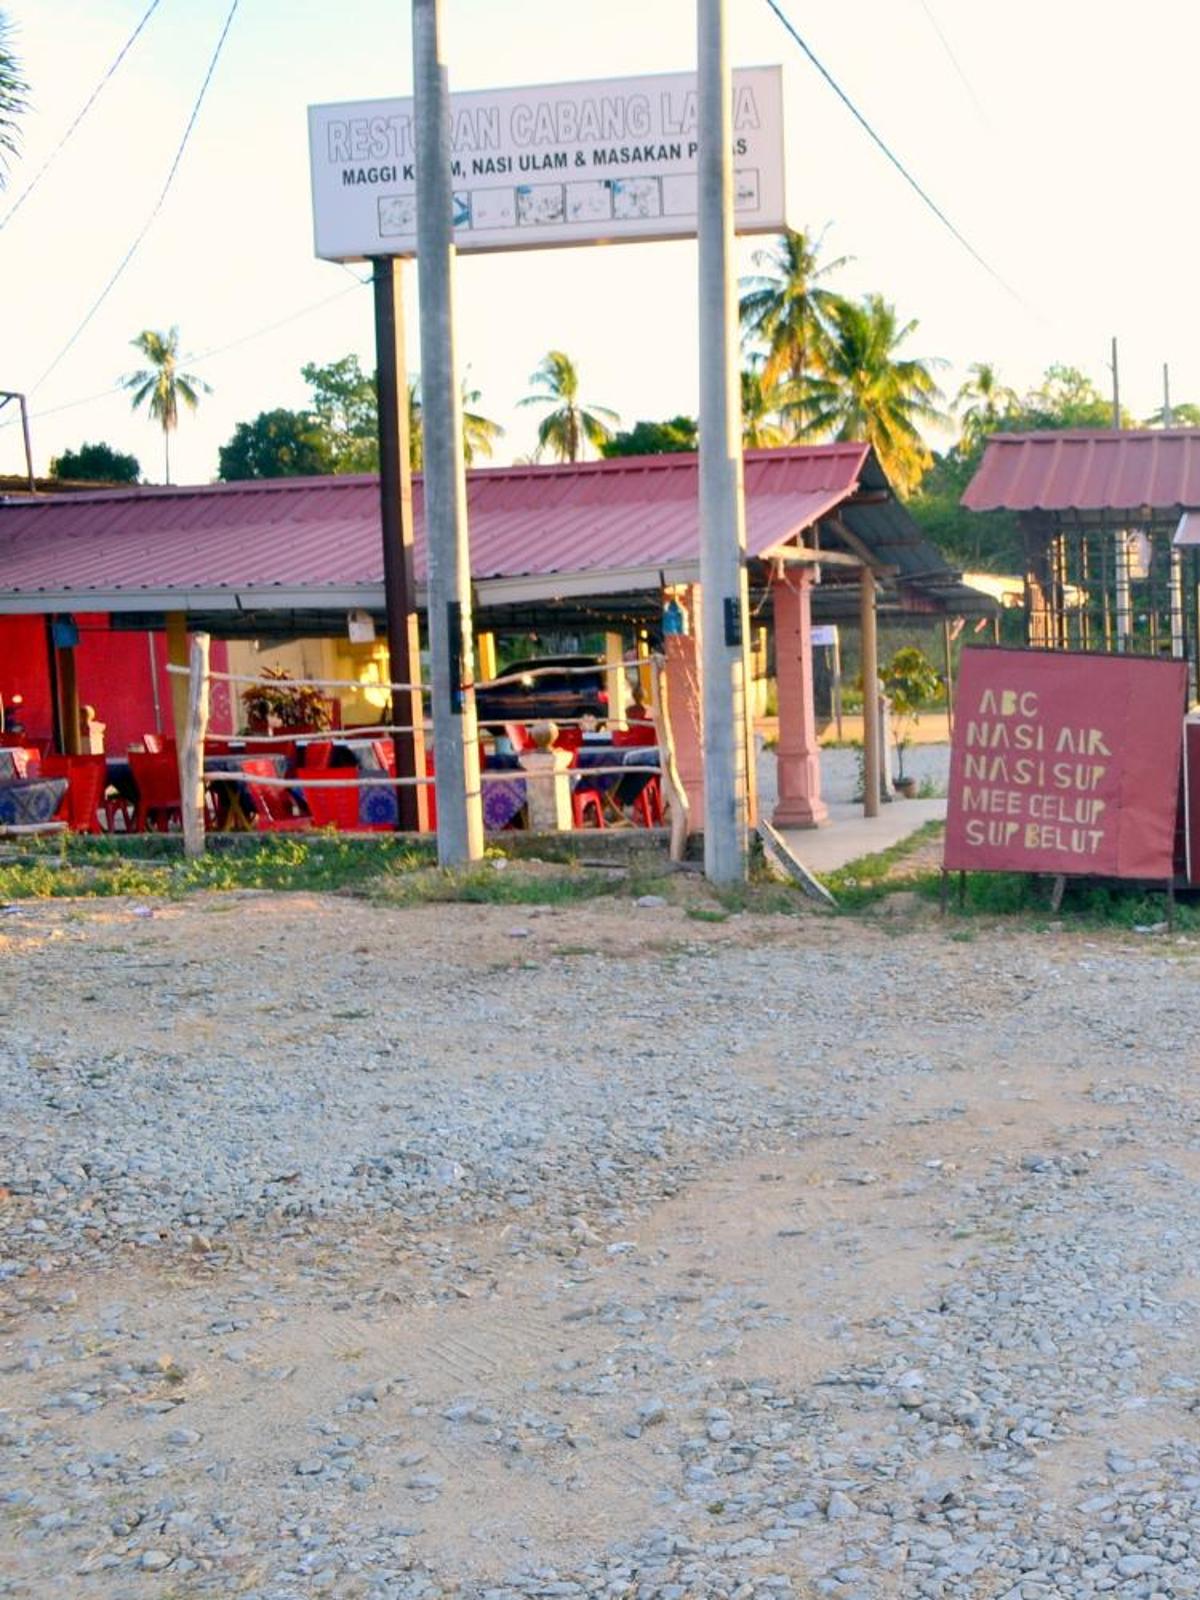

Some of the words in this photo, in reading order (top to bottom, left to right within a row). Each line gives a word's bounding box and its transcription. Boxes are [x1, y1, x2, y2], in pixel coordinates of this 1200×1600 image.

[327, 105, 500, 163] RESTAN
[510, 93, 650, 149] CABANG
[661, 86, 761, 136] LAA
[342, 166, 397, 186] MAGGI
[472, 156, 512, 175] NASI
[519, 152, 567, 172] ULAM
[574, 151, 586, 167] &
[593, 144, 681, 166] MASAKAN
[979, 689, 1038, 717] ABC
[966, 721, 1043, 751] NASI
[1055, 727, 1112, 756] AIR
[963, 753, 1045, 787] NASI
[1053, 763, 1106, 791] SUP
[961, 786, 1021, 815] MEE
[1029, 794, 1106, 825] CELUP
[965, 819, 1019, 846] SUP
[1024, 823, 1104, 854] BELUT
